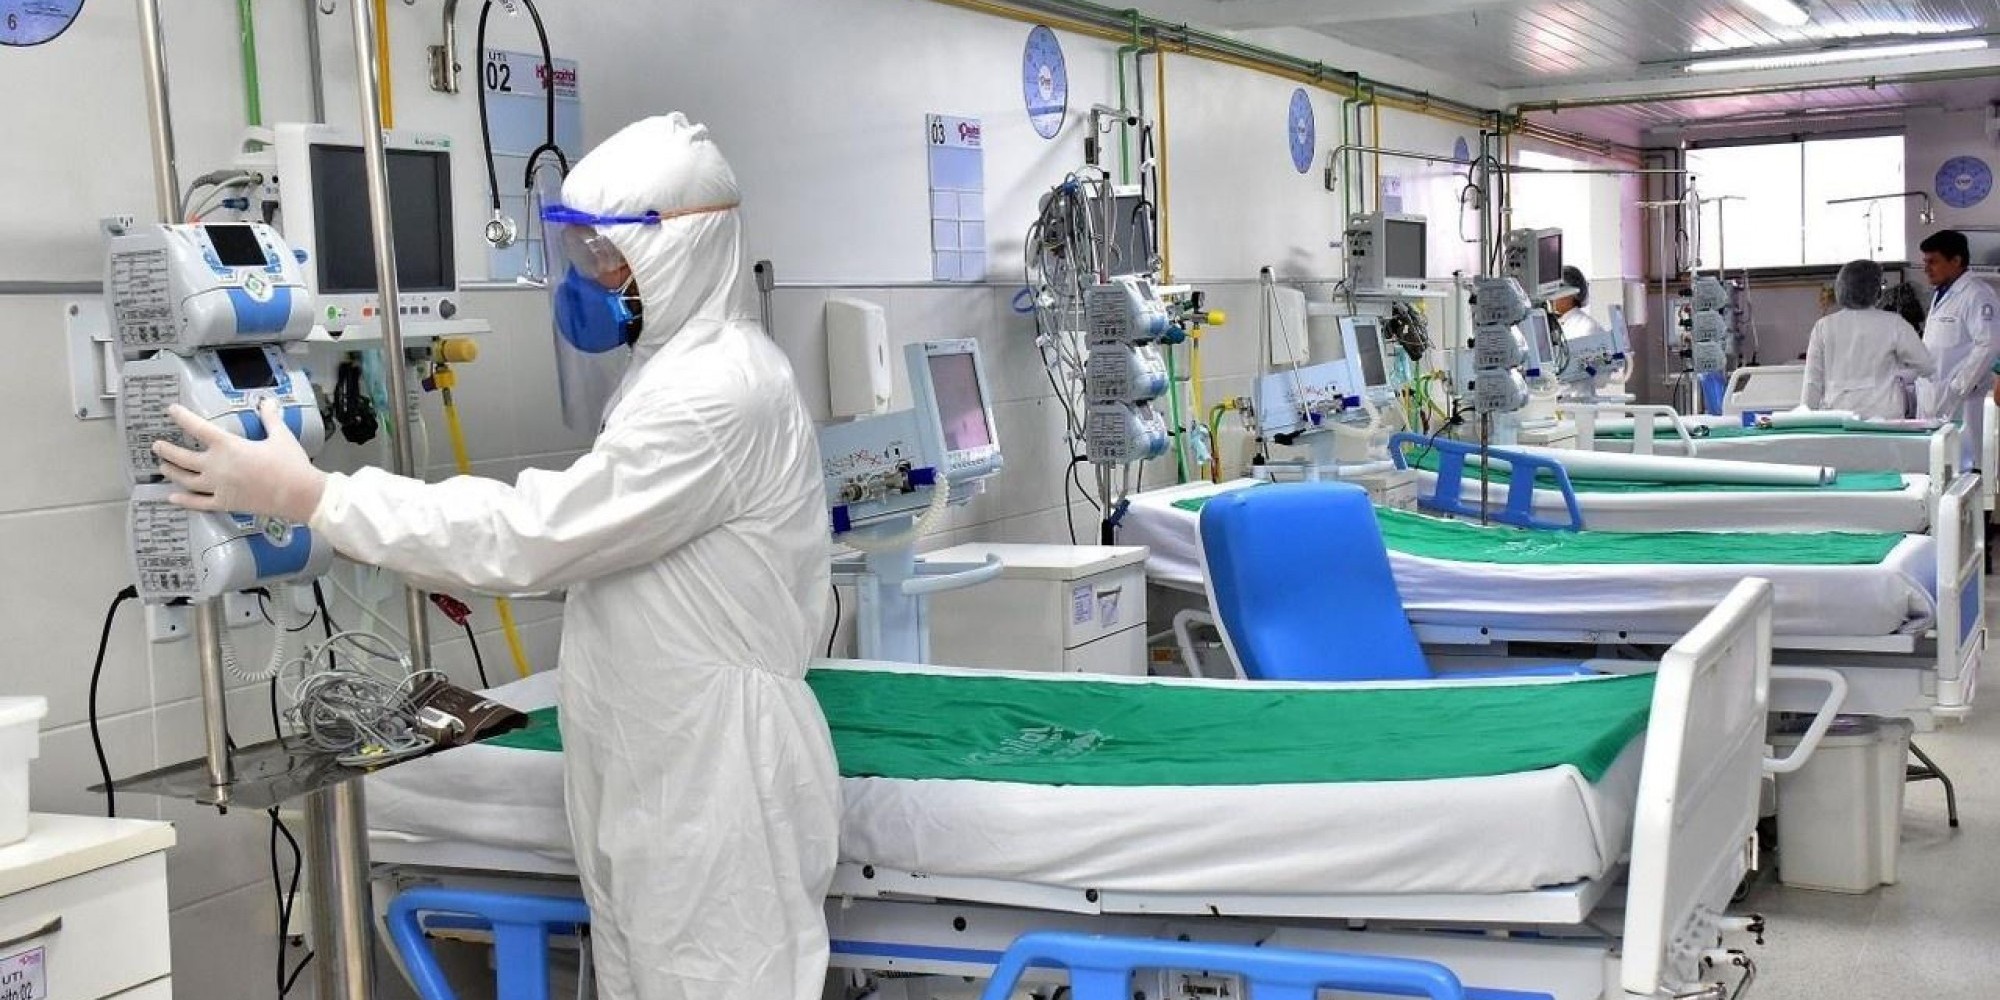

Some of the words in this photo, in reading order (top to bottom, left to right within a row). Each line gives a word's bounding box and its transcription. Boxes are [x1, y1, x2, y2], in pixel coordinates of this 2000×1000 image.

[7, 13, 17, 30] 6
[488, 51, 507, 61] UTI
[486, 62, 511, 91] 02
[931, 122, 946, 144] 03
[2, 970, 23, 985] UTI
